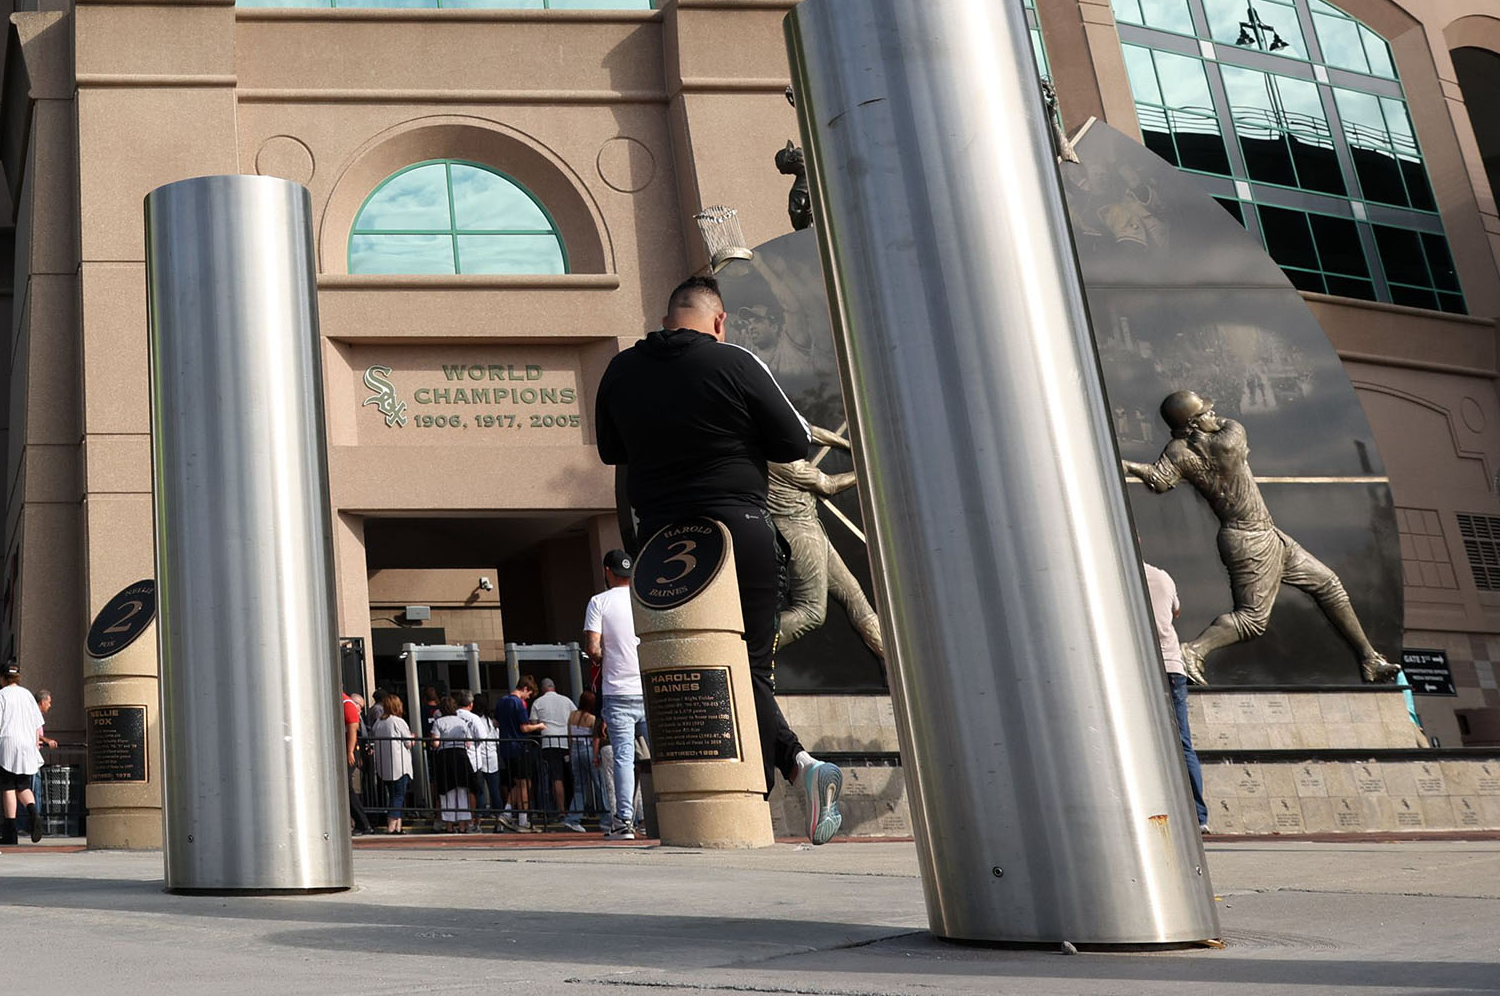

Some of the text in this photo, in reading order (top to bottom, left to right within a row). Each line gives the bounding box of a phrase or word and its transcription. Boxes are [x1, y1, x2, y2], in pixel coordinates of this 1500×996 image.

[442, 364, 544, 381] WORLD
[413, 387, 578, 405] CHAMPIONS
[413, 414, 581, 429] 1906, 1917, 2005
[663, 525, 713, 539] HAROLD
[656, 540, 697, 584] 3
[649, 585, 689, 597] BAINES
[103, 600, 143, 634] 2
[651, 673, 700, 683] HAROLD
[654, 683, 700, 693] BAINES
